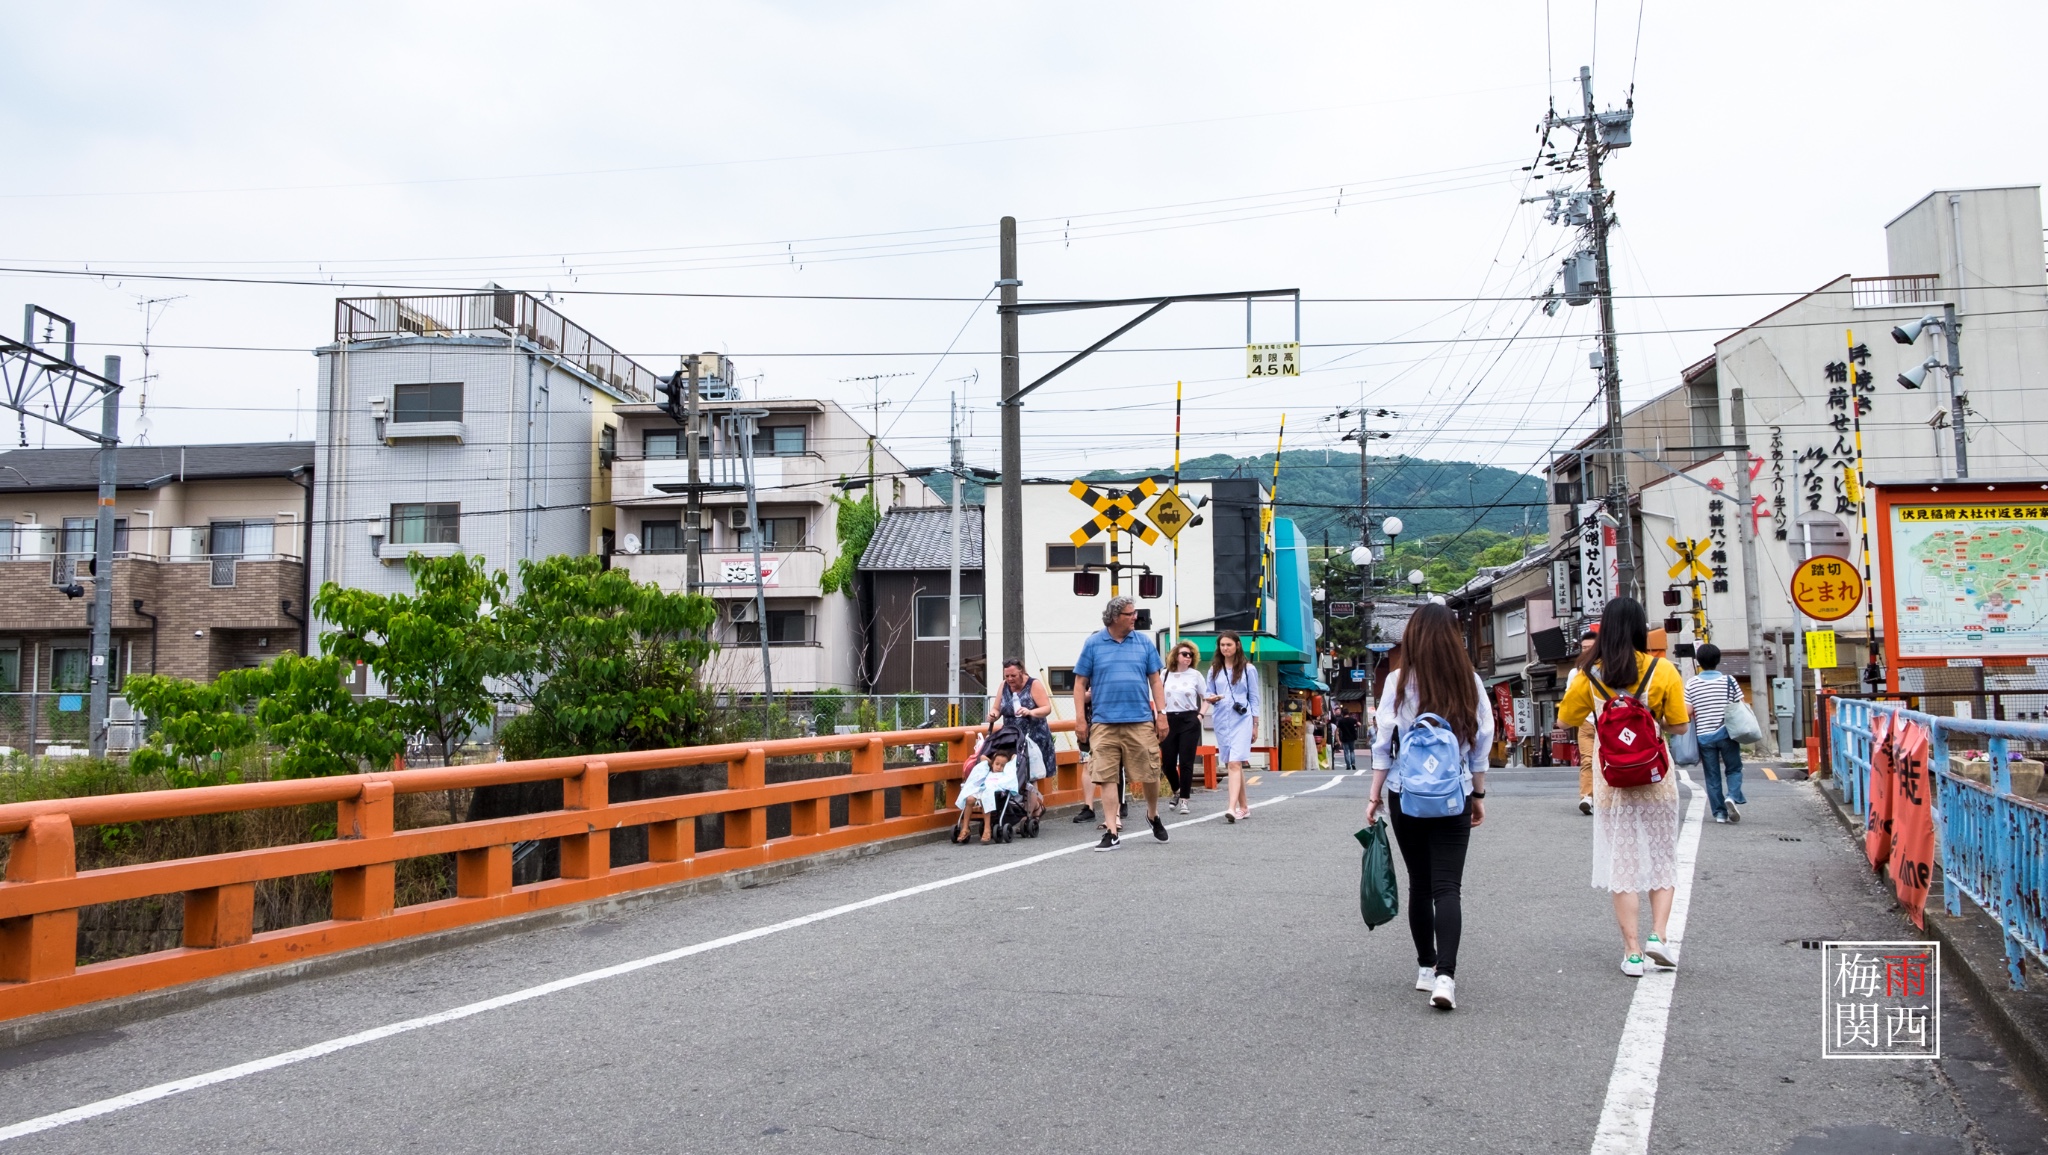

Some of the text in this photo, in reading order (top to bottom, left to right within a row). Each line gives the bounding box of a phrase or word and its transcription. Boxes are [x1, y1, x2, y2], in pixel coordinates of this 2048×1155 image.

[1252, 352, 1294, 363] 制限高
[1584, 515, 1603, 599] 味噌せんべい
[1811, 563, 1841, 576] 踏切
[1798, 581, 1857, 602] とまれ
